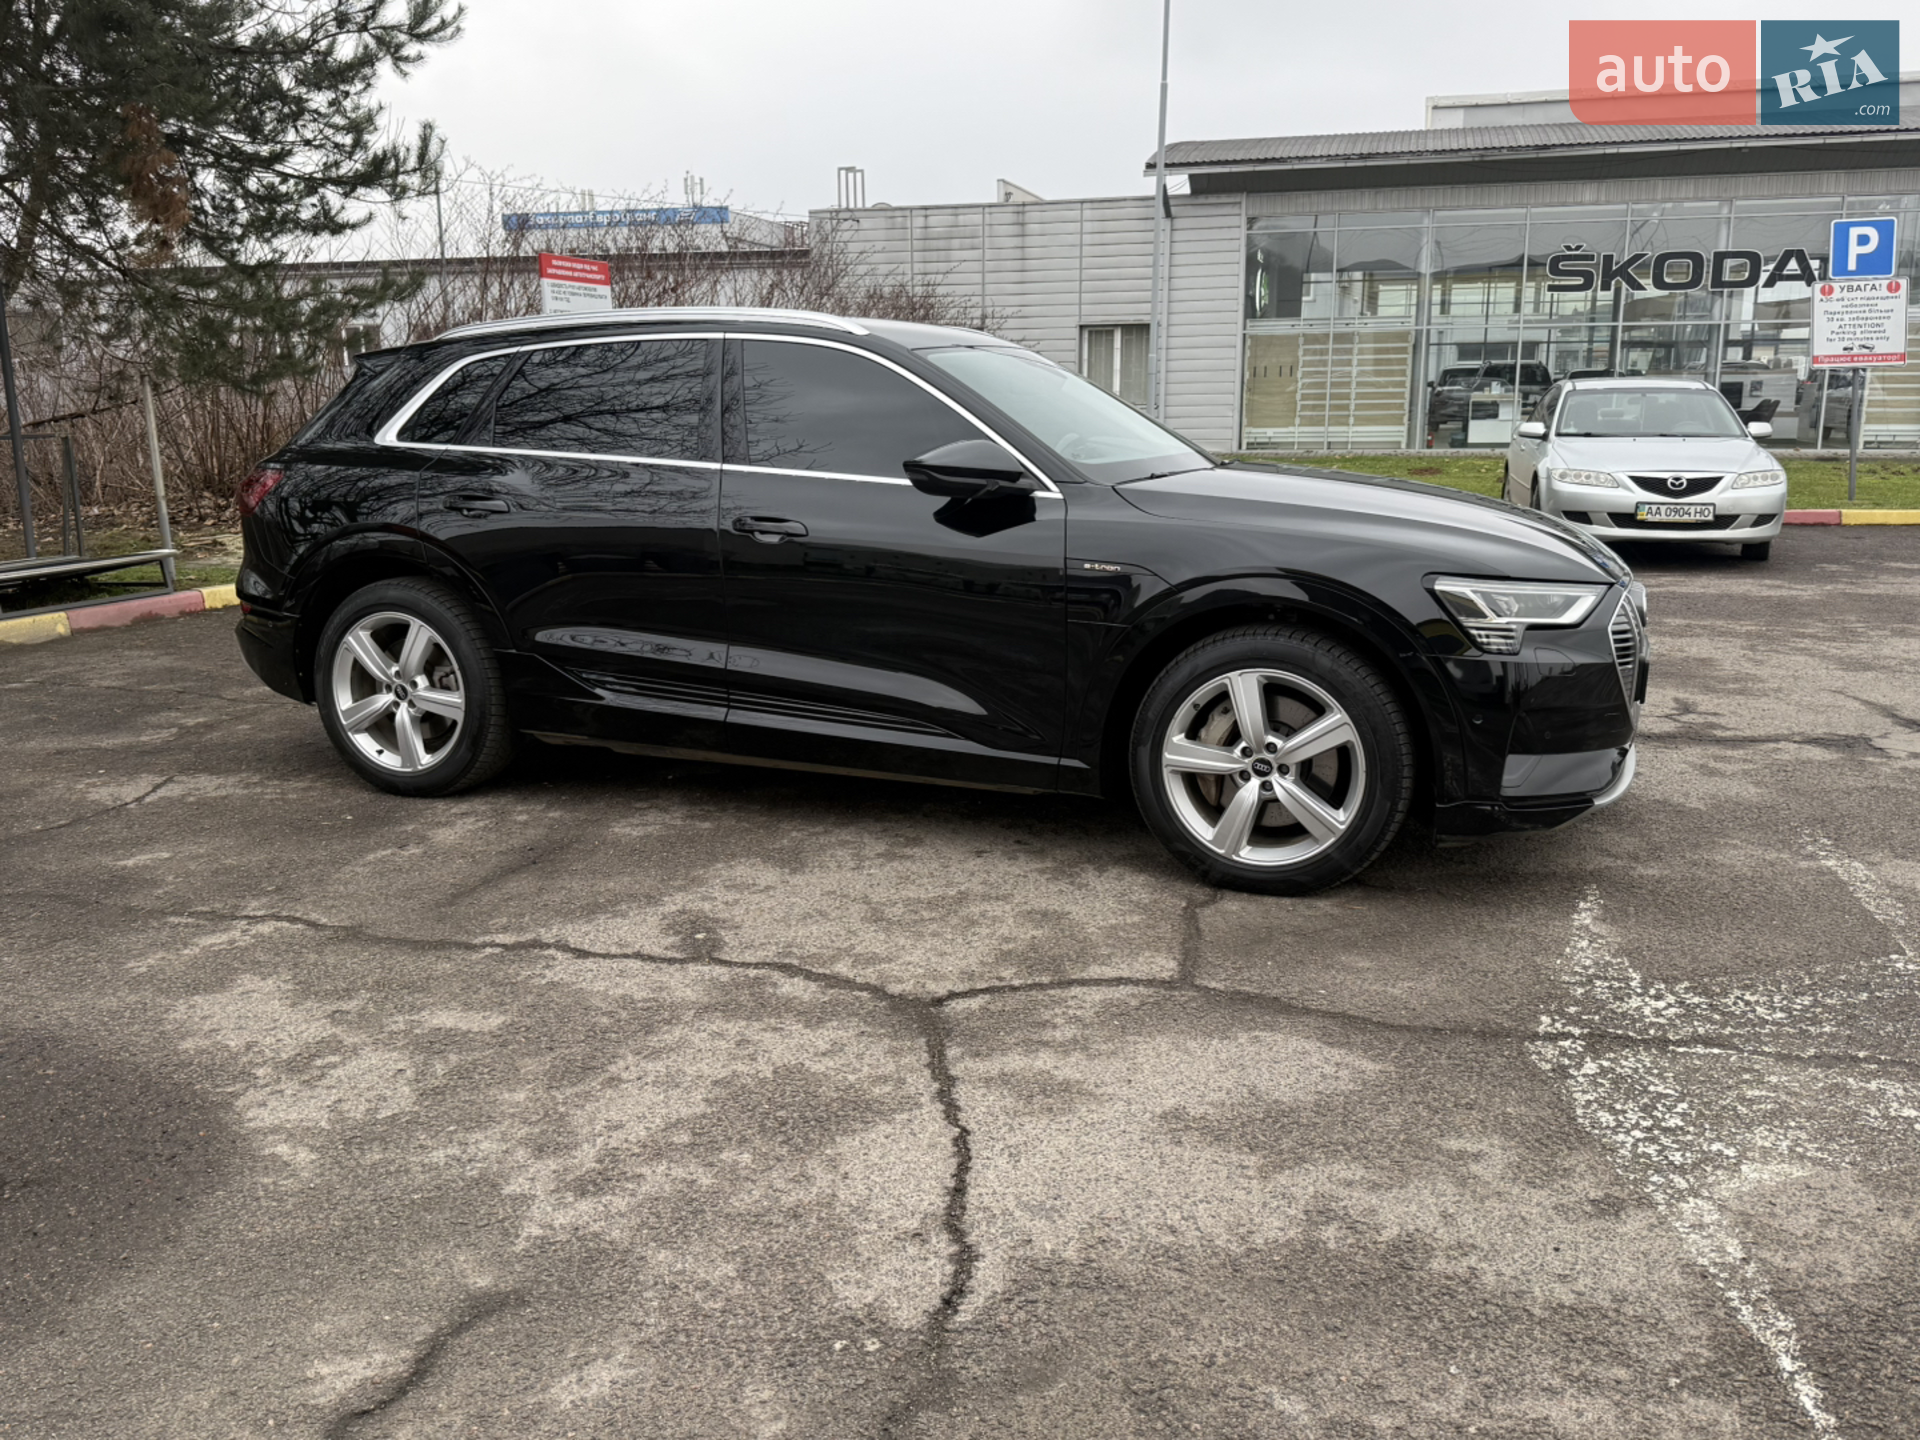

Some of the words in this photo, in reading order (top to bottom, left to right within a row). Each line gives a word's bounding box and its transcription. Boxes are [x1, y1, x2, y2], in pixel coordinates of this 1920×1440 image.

[1847, 226, 1879, 272] P
[1546, 244, 1817, 292] ŠKODA
[1839, 283, 1882, 293] УВАГА!
[1837, 322, 1885, 330] ATTENTION!
[1818, 356, 1852, 364] Працює
[1646, 506, 1662, 517] AA
[1664, 506, 1691, 518] 0904
[1084, 563, 1121, 572] e-tron
